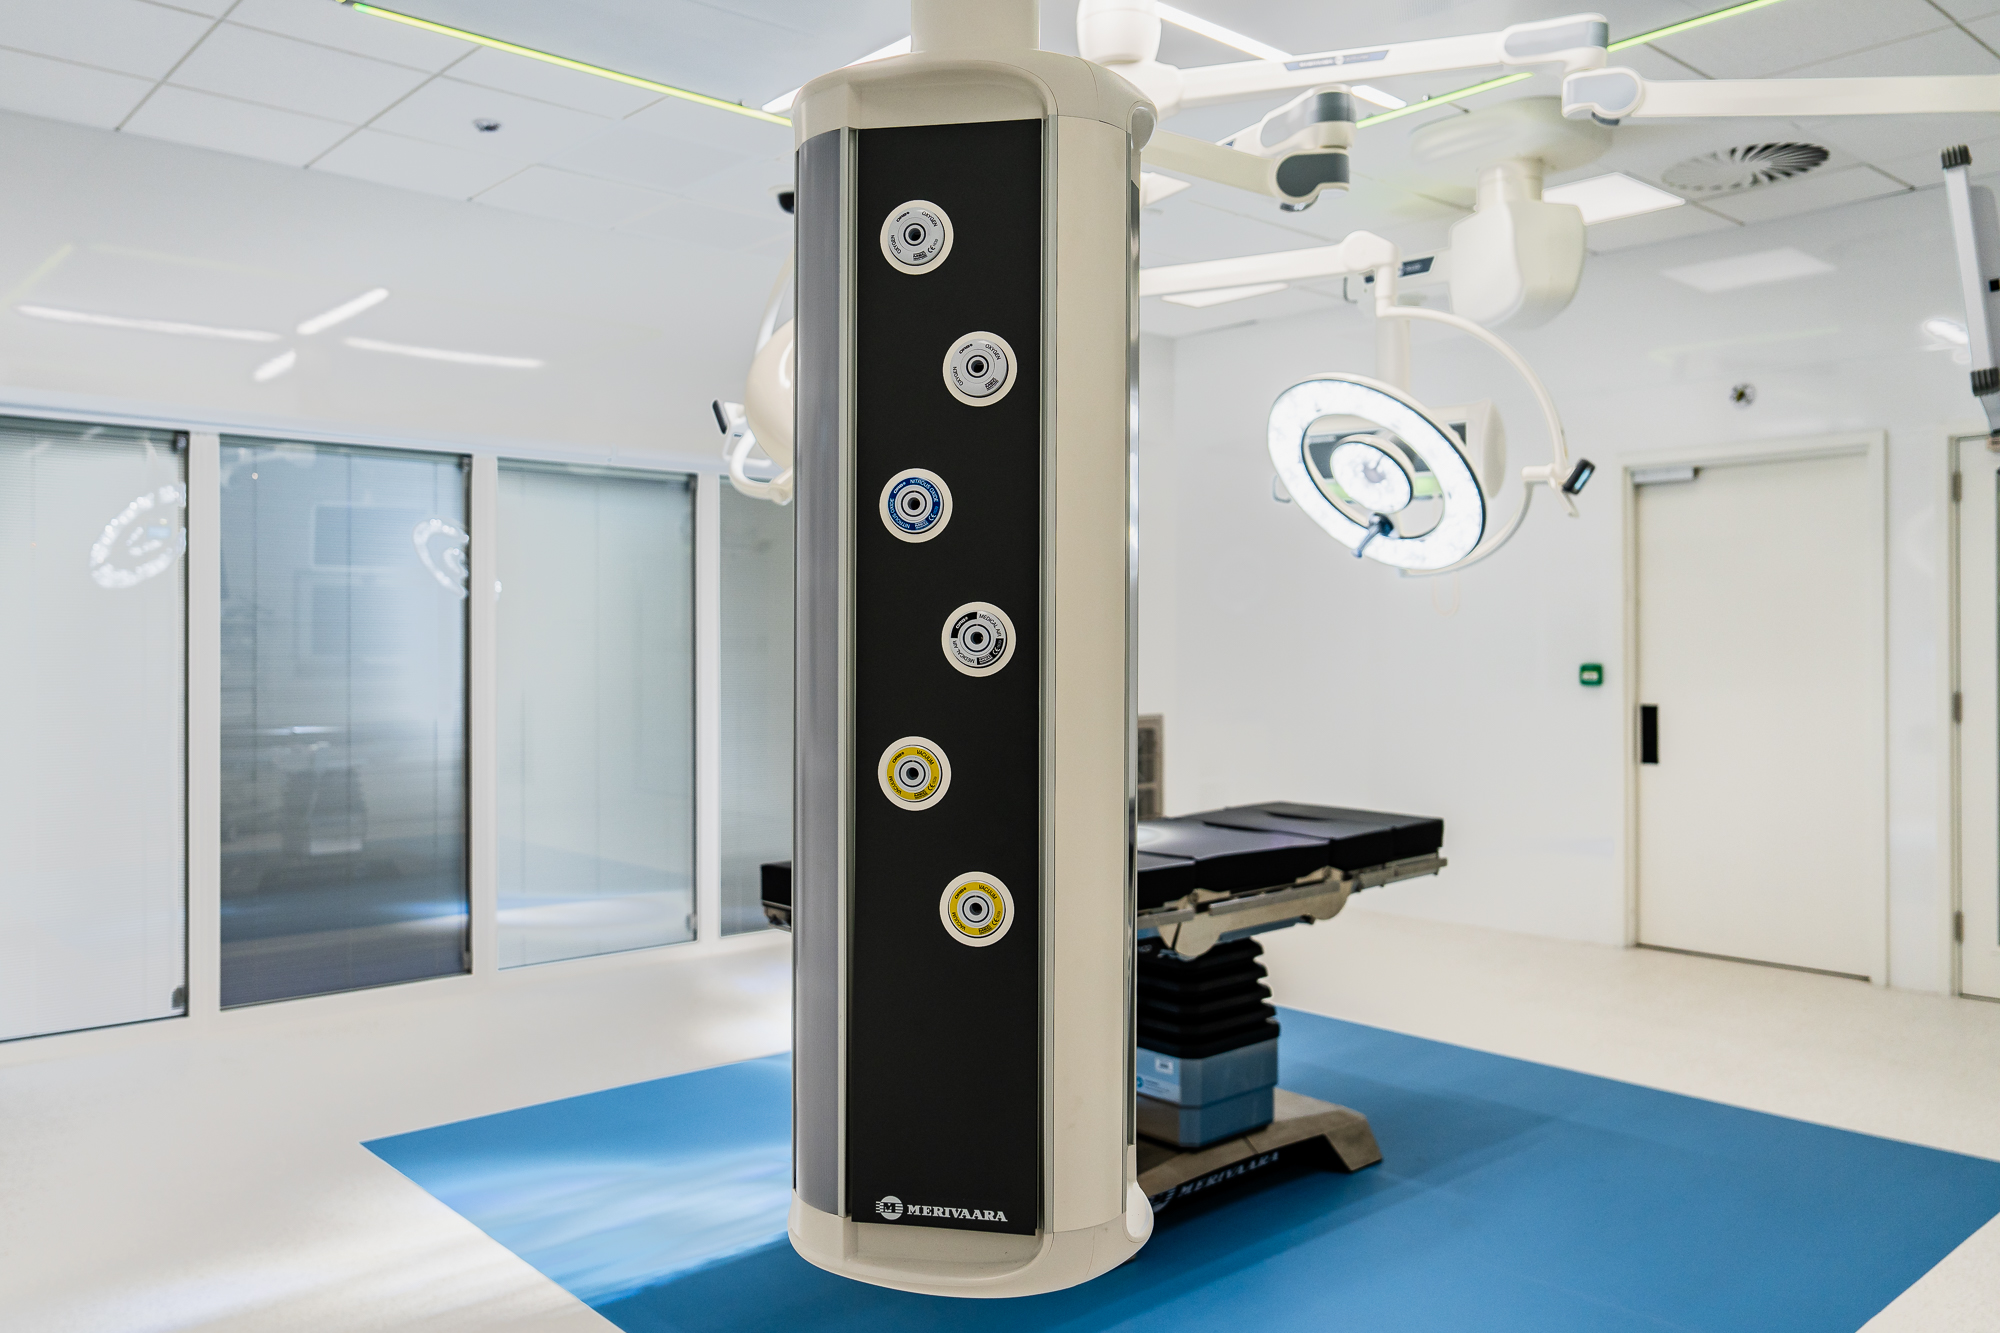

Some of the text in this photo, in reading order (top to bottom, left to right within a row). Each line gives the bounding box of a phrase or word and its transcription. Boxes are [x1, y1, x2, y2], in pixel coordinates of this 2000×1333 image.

[921, 211, 938, 227] OXYGEN
[891, 234, 902, 254] OXYGEN
[985, 343, 1001, 360] OXYGEN
[953, 366, 964, 386] OXYGEN
[979, 613, 998, 629] MEDICAL
[956, 648, 976, 664] MEDICAL
[916, 749, 935, 766] VACUUM
[978, 884, 998, 900] VACUUM
[907, 1204, 1008, 1222] MERIVAARA
